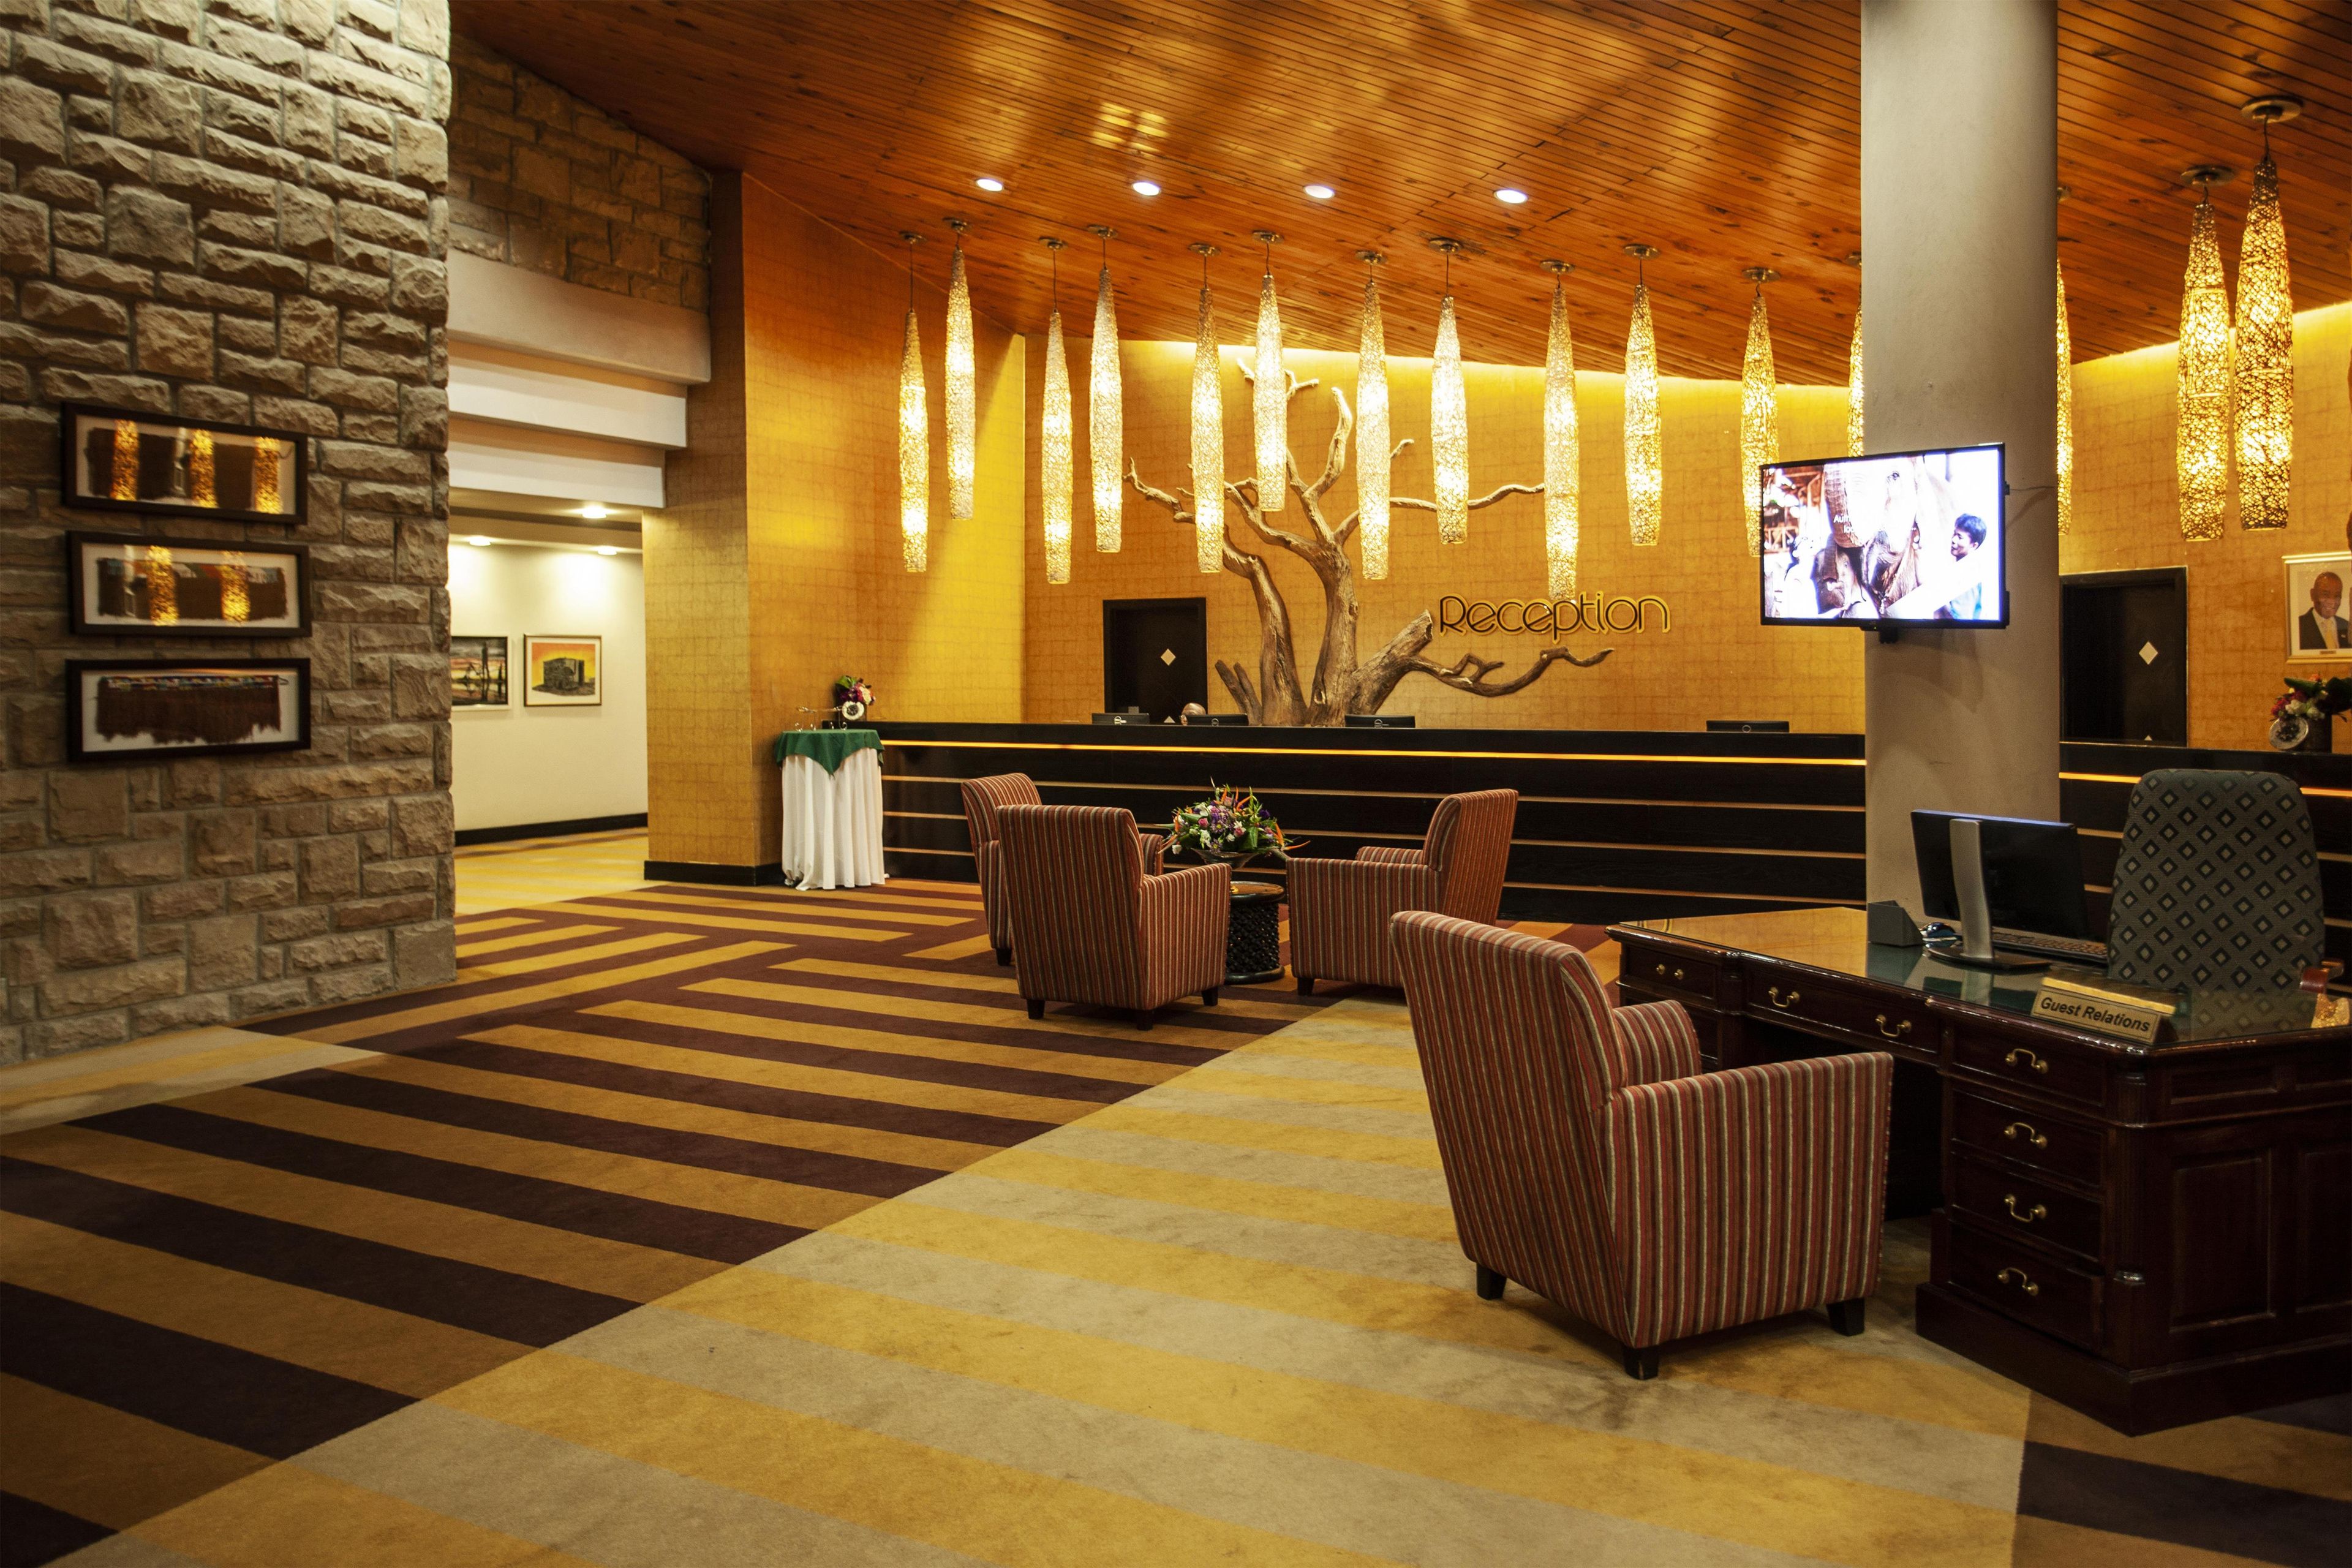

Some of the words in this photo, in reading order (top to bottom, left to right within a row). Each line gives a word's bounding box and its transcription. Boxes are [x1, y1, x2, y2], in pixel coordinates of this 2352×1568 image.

[1439, 592, 1670, 643] Reception
[2041, 997, 2081, 1016] Guest
[2082, 1006, 2150, 1031] Relations
